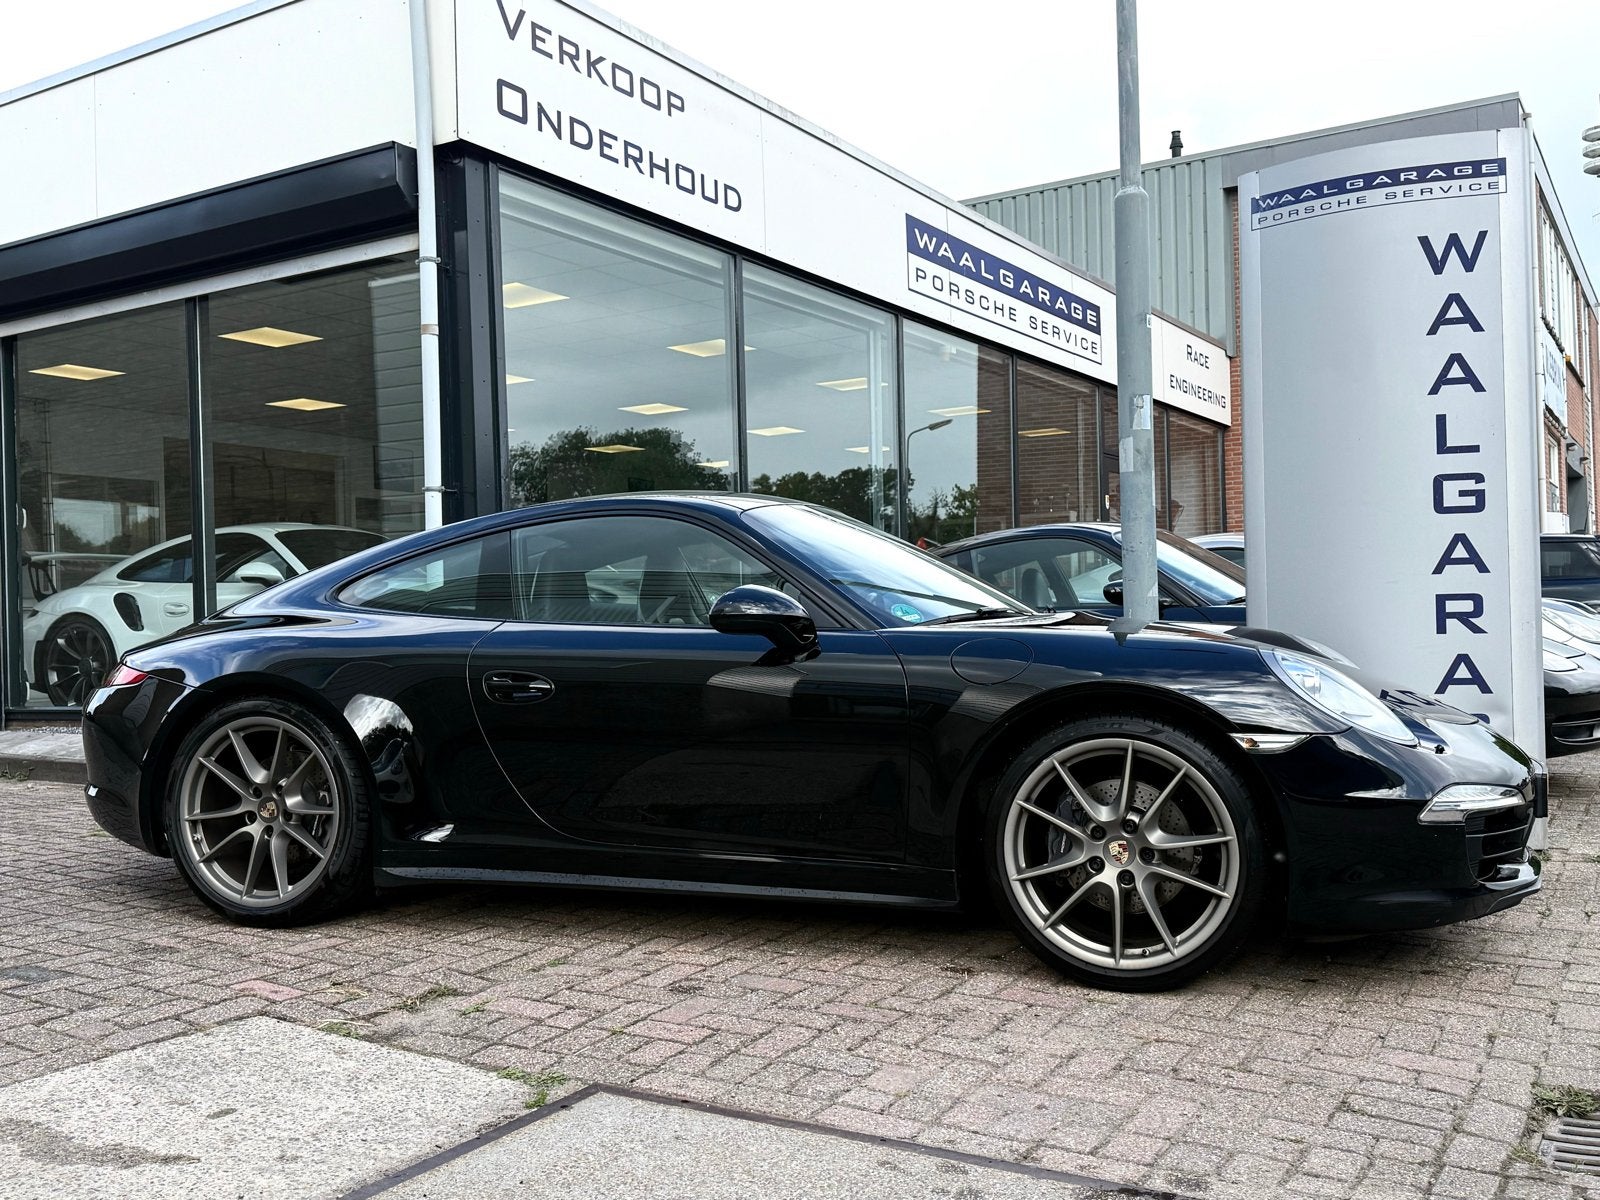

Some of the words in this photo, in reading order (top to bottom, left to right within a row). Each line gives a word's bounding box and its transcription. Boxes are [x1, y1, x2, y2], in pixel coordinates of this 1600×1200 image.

[496, 0, 685, 116] VERKOOP
[497, 78, 742, 212] ONDERHOUD
[1258, 163, 1499, 209] WAALGARAGE
[1258, 195, 1367, 225] PORSCHE
[1385, 181, 1499, 200] SERVICE
[914, 228, 1098, 327] WAALGARAGE
[915, 267, 1017, 322] PORSCHE
[1029, 316, 1098, 355] SERVICE
[1170, 374, 1227, 408] ENGINEERING
[1187, 344, 1210, 369] RACE
[1417, 230, 1493, 724] WAALGARA
